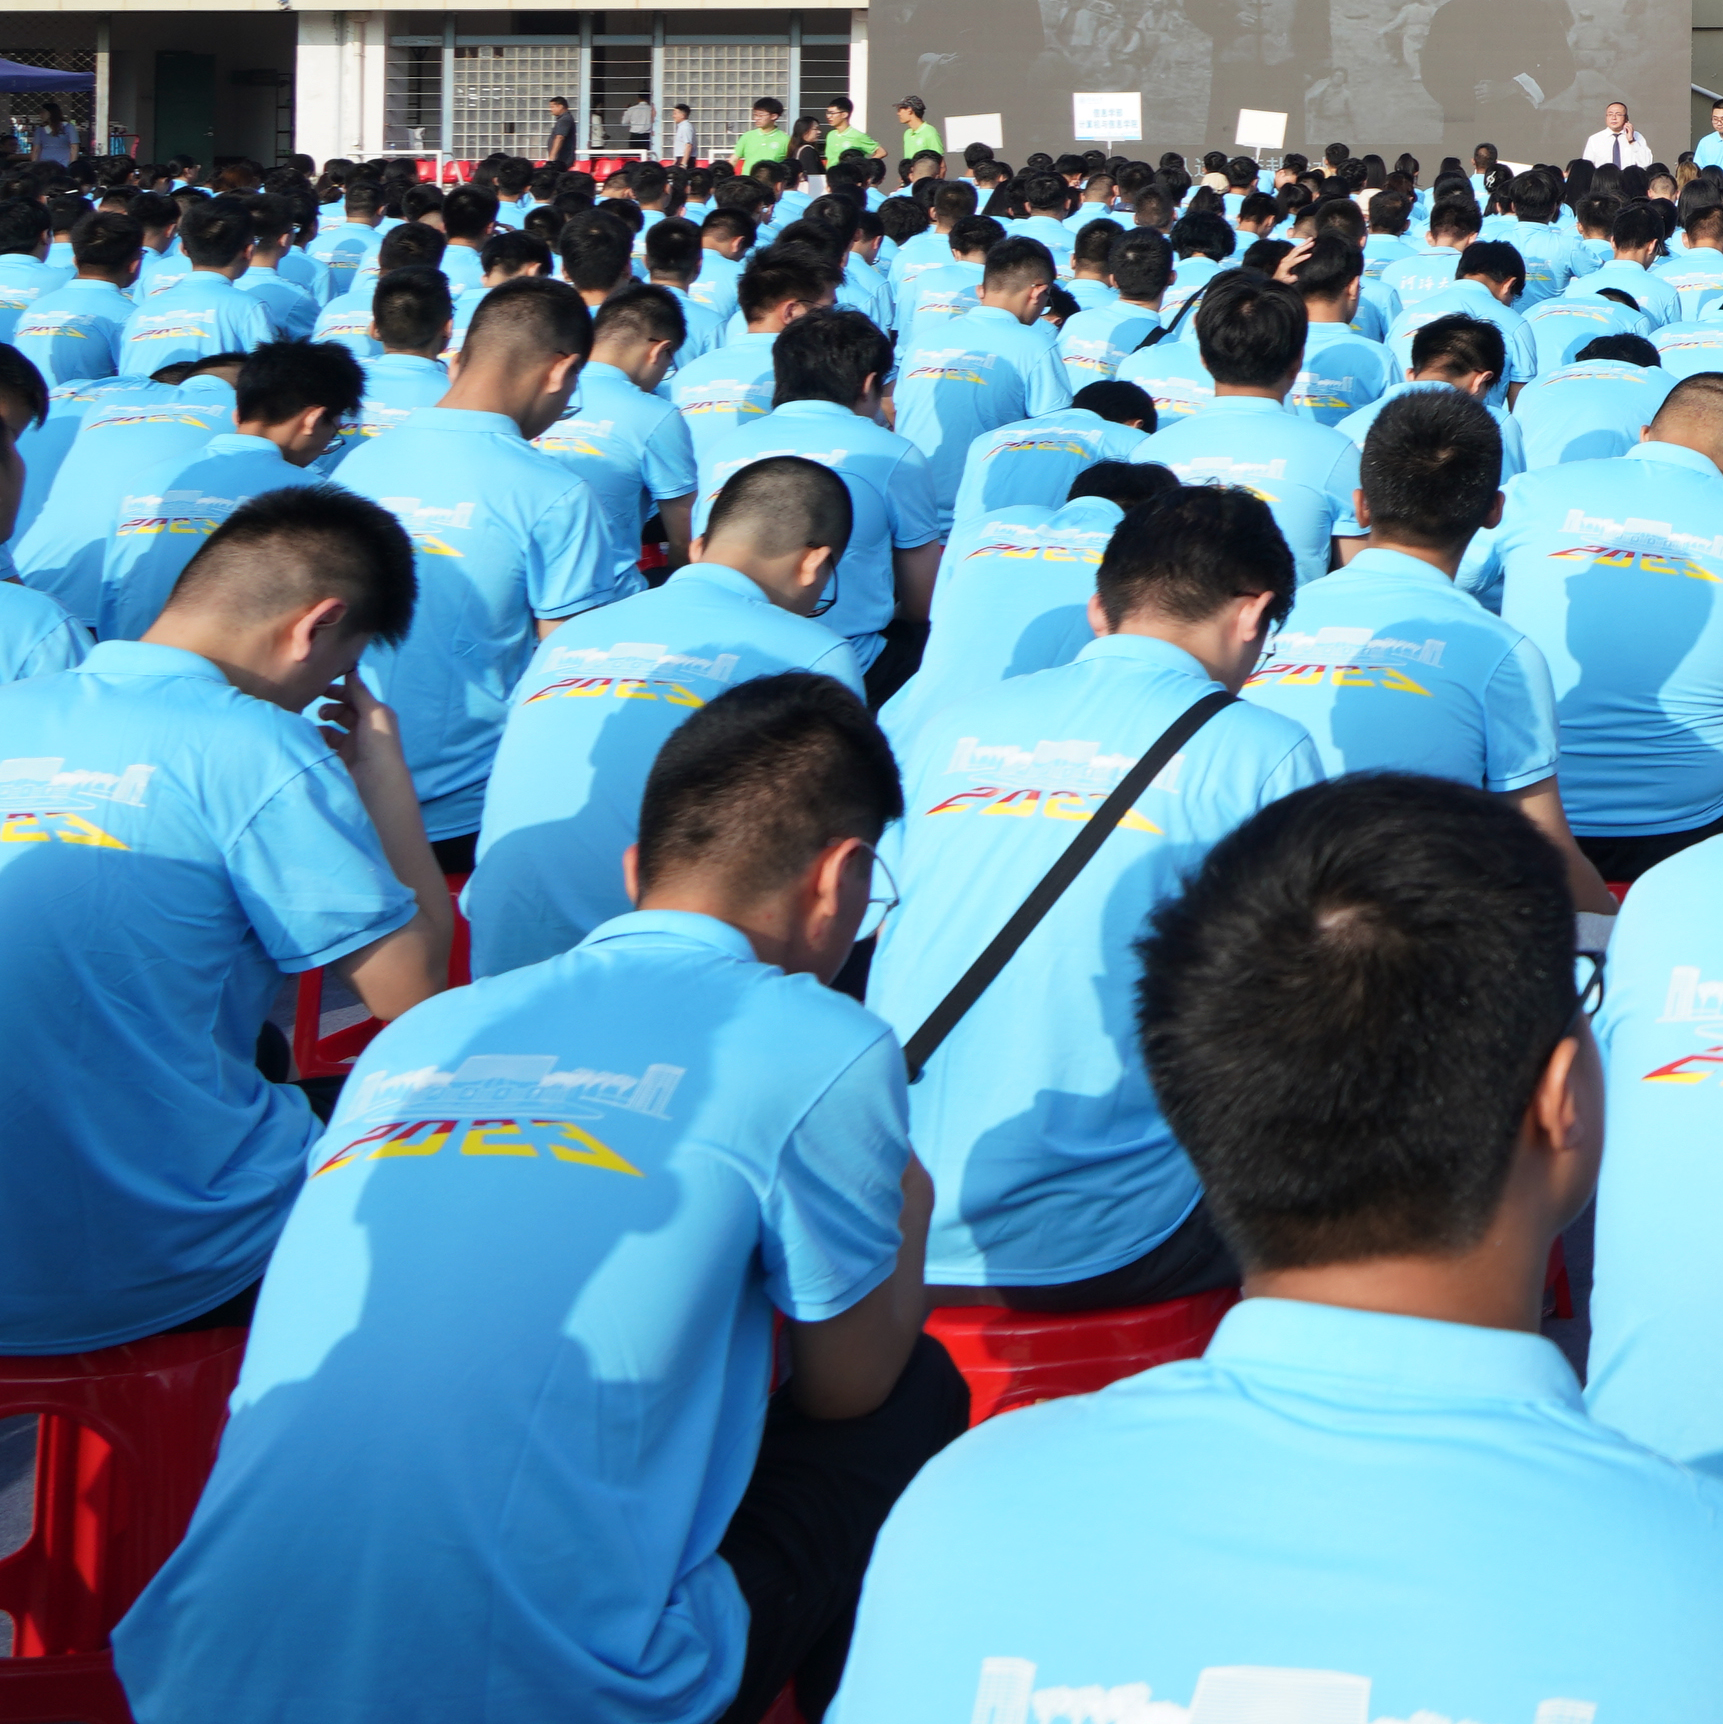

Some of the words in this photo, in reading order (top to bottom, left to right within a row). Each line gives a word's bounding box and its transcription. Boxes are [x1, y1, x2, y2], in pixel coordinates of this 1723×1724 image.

[131, 325, 211, 341] 2023
[317, 325, 370, 338] 202
[907, 366, 988, 386] 2023
[86, 414, 212, 431] 2023
[982, 440, 1091, 461] 2023
[524, 677, 705, 709] 2023
[310, 1117, 647, 1179] 2023
